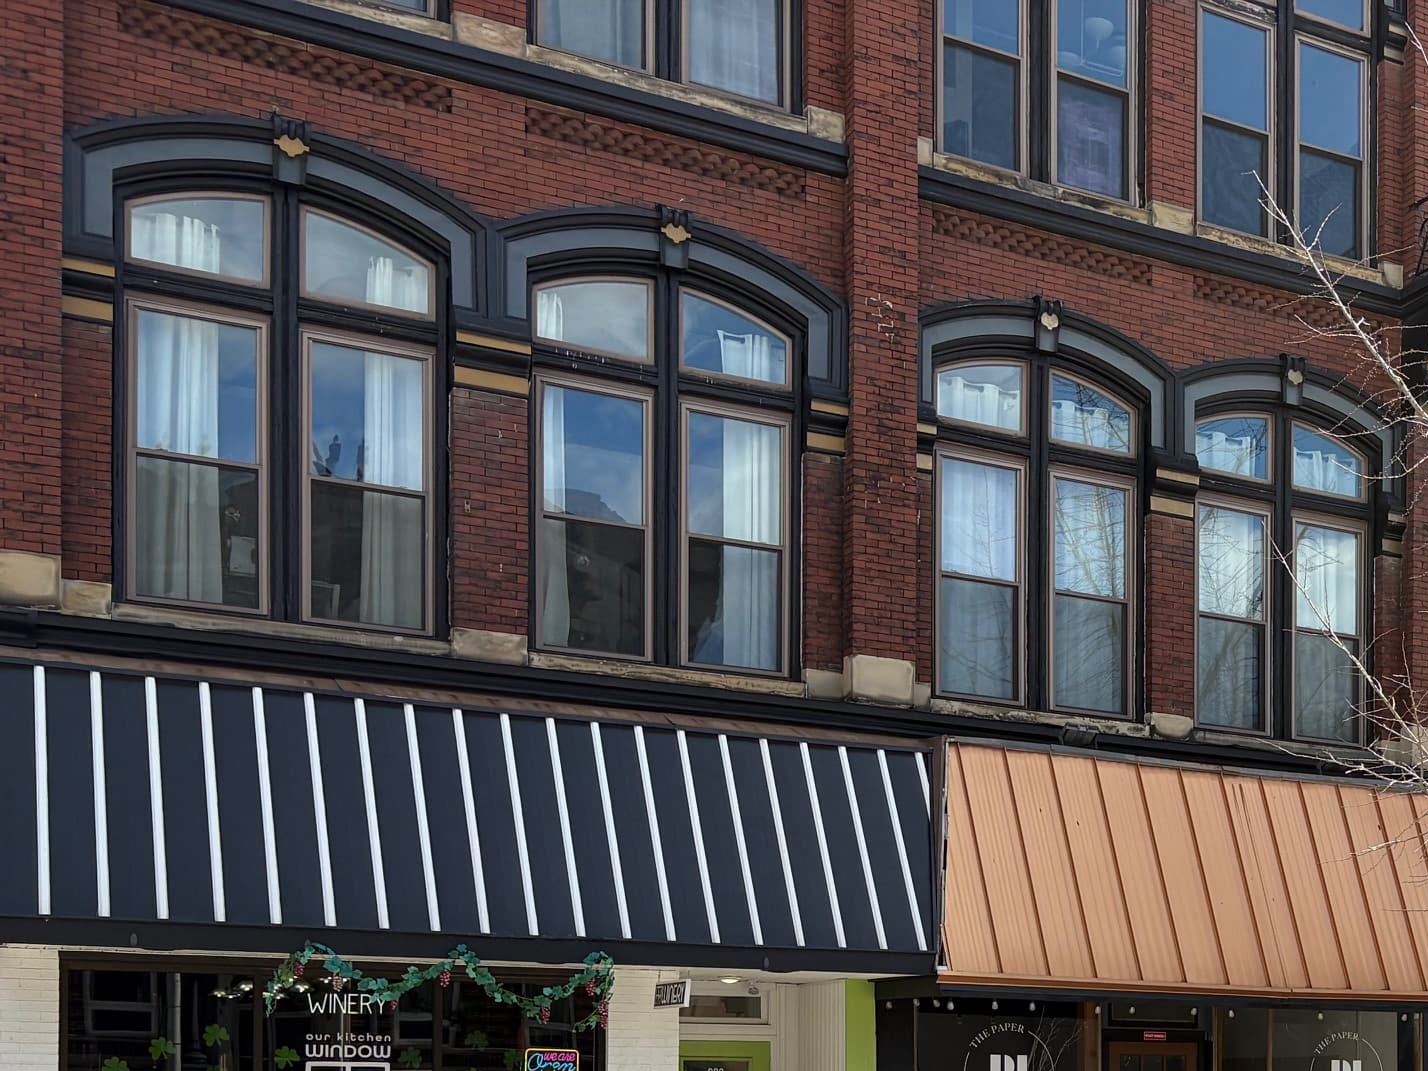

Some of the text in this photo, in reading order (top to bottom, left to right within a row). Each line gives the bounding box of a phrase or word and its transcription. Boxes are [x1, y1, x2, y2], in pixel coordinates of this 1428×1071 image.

[307, 993, 386, 1015] WINERY
[305, 1032, 391, 1042] our kitchen
[969, 1022, 1025, 1048] THE PAPER
[1313, 1031, 1360, 1055] THE PAPER
[305, 1044, 392, 1058] WINDOW
[544, 1052, 576, 1062] we are
